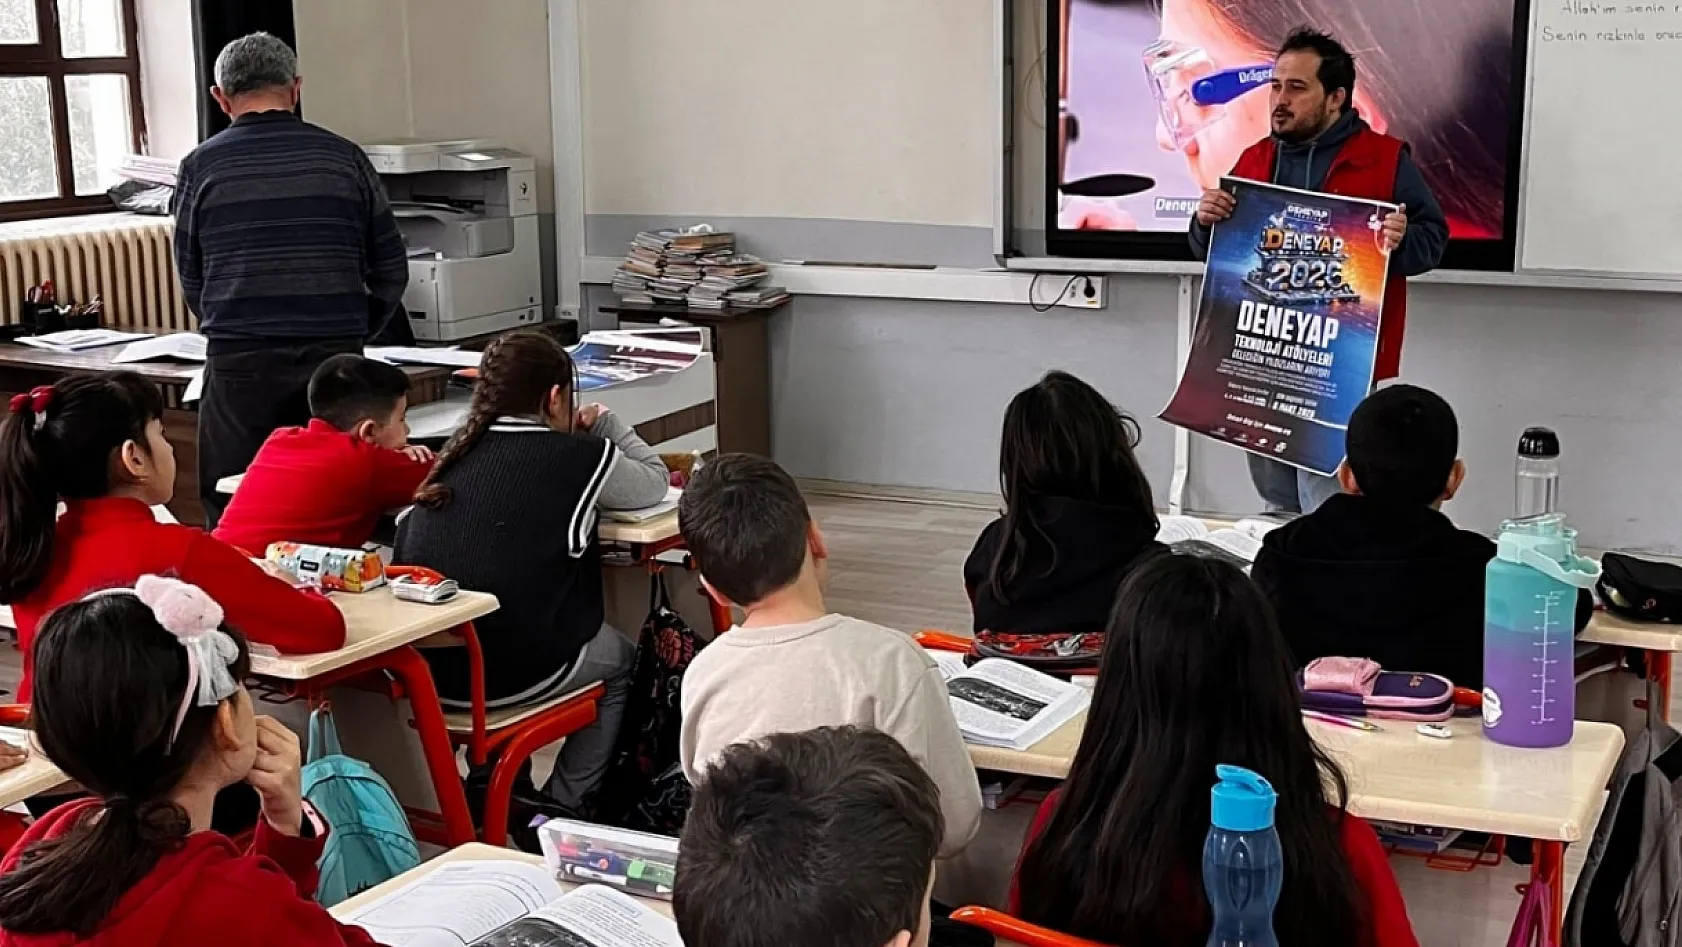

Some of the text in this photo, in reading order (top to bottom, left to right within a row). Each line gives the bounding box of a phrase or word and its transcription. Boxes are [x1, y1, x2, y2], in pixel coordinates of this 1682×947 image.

[1542, 25, 1588, 42] Senin
[1264, 228, 1343, 252] DENEYAP
[1237, 300, 1339, 348] DENEYAP
[1234, 333, 1333, 367] TEKNOLOJİ ATÖLYELERİ
